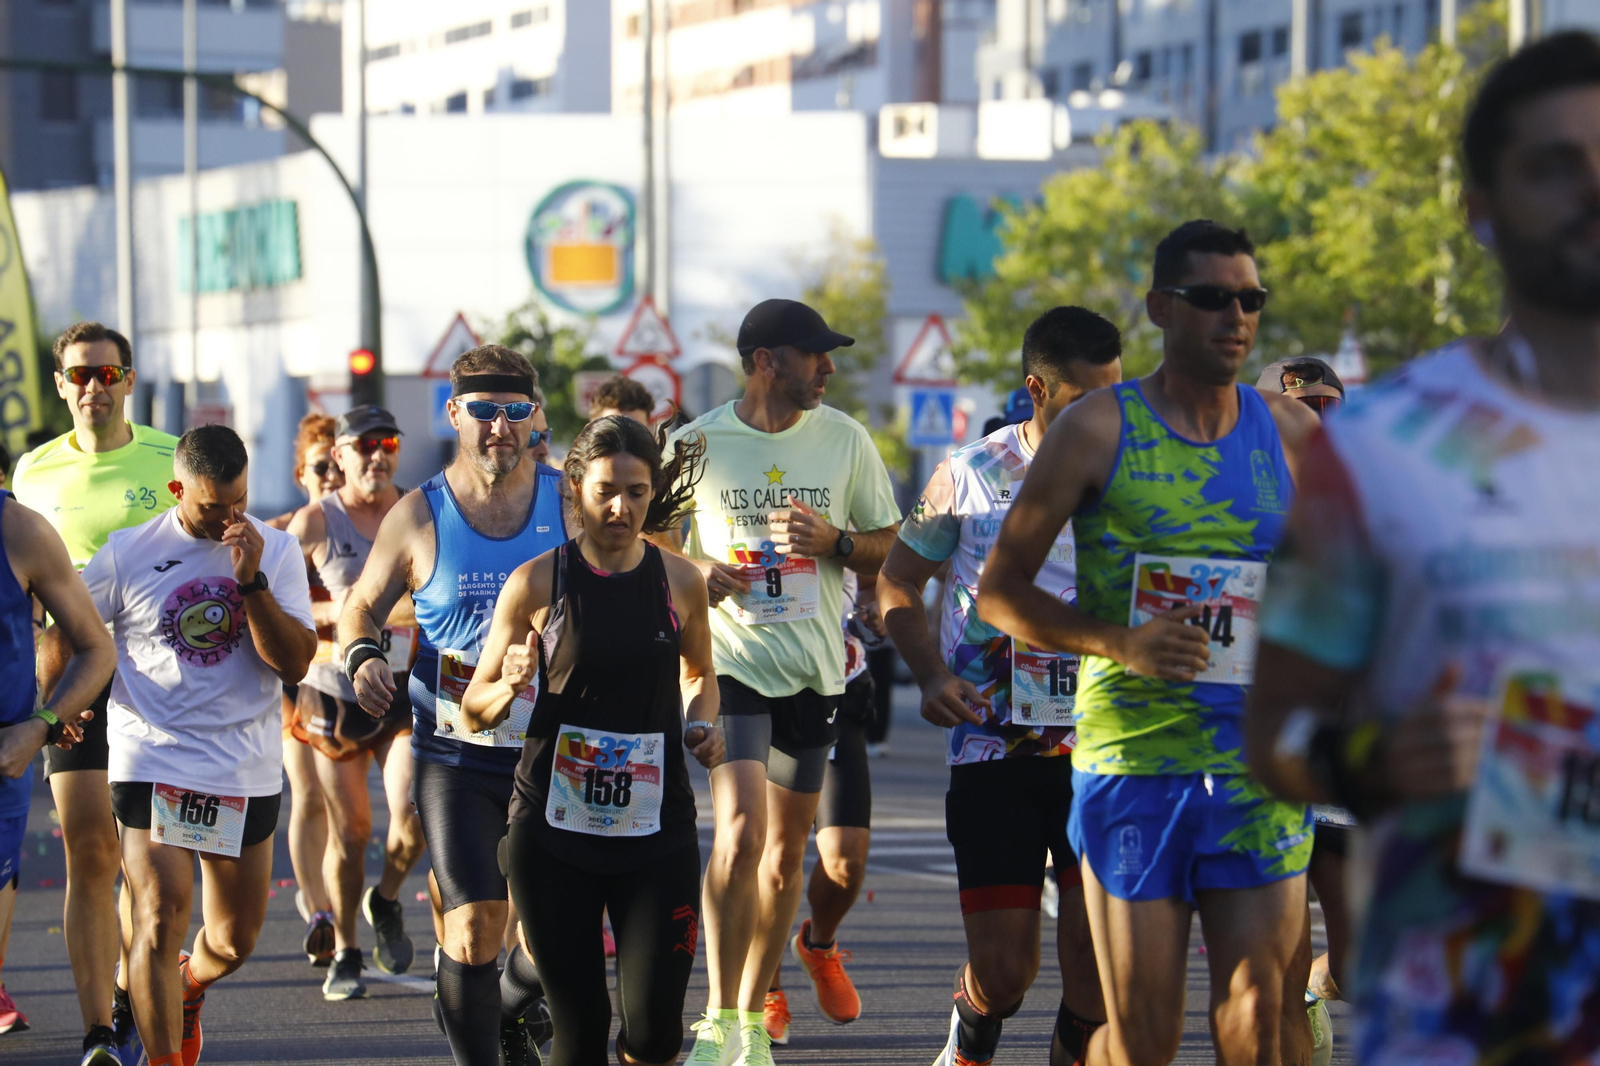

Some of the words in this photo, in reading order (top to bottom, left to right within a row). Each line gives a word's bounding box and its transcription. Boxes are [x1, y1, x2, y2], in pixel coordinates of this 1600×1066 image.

[139, 486, 158, 510] 25
[720, 488, 749, 511] MIS
[736, 512, 768, 527] ESTÁN
[458, 572, 508, 582] MEMO
[458, 582, 496, 590] SARGENTO
[765, 567, 783, 598] 9
[176, 594, 189, 607] A
[189, 583, 212, 599] LA
[162, 608, 195, 662] LENGUA
[380, 629, 392, 653] 8
[1046, 660, 1078, 697] 15
[583, 768, 633, 808] 158
[179, 792, 221, 827] 156
